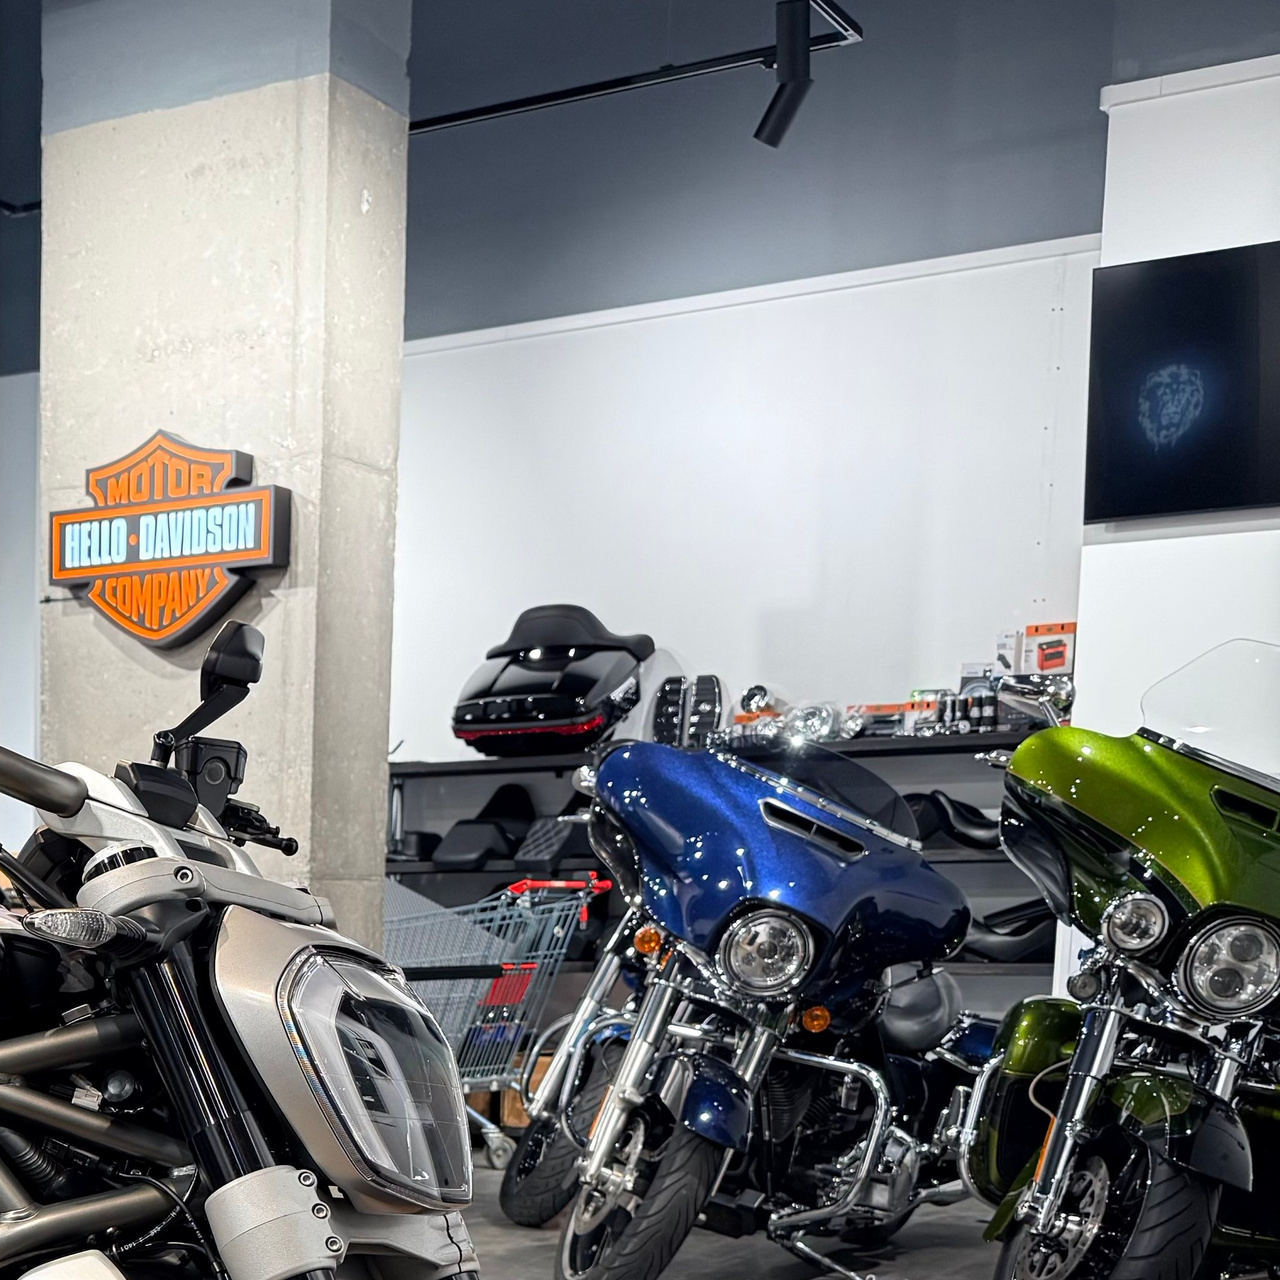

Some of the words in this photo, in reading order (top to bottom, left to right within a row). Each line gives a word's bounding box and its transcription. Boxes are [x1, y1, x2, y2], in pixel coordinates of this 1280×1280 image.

[107, 451, 212, 504] MOTOR
[65, 517, 127, 569] HELLO
[139, 502, 256, 560] DAVIDSON
[105, 567, 211, 629] COMPANY
